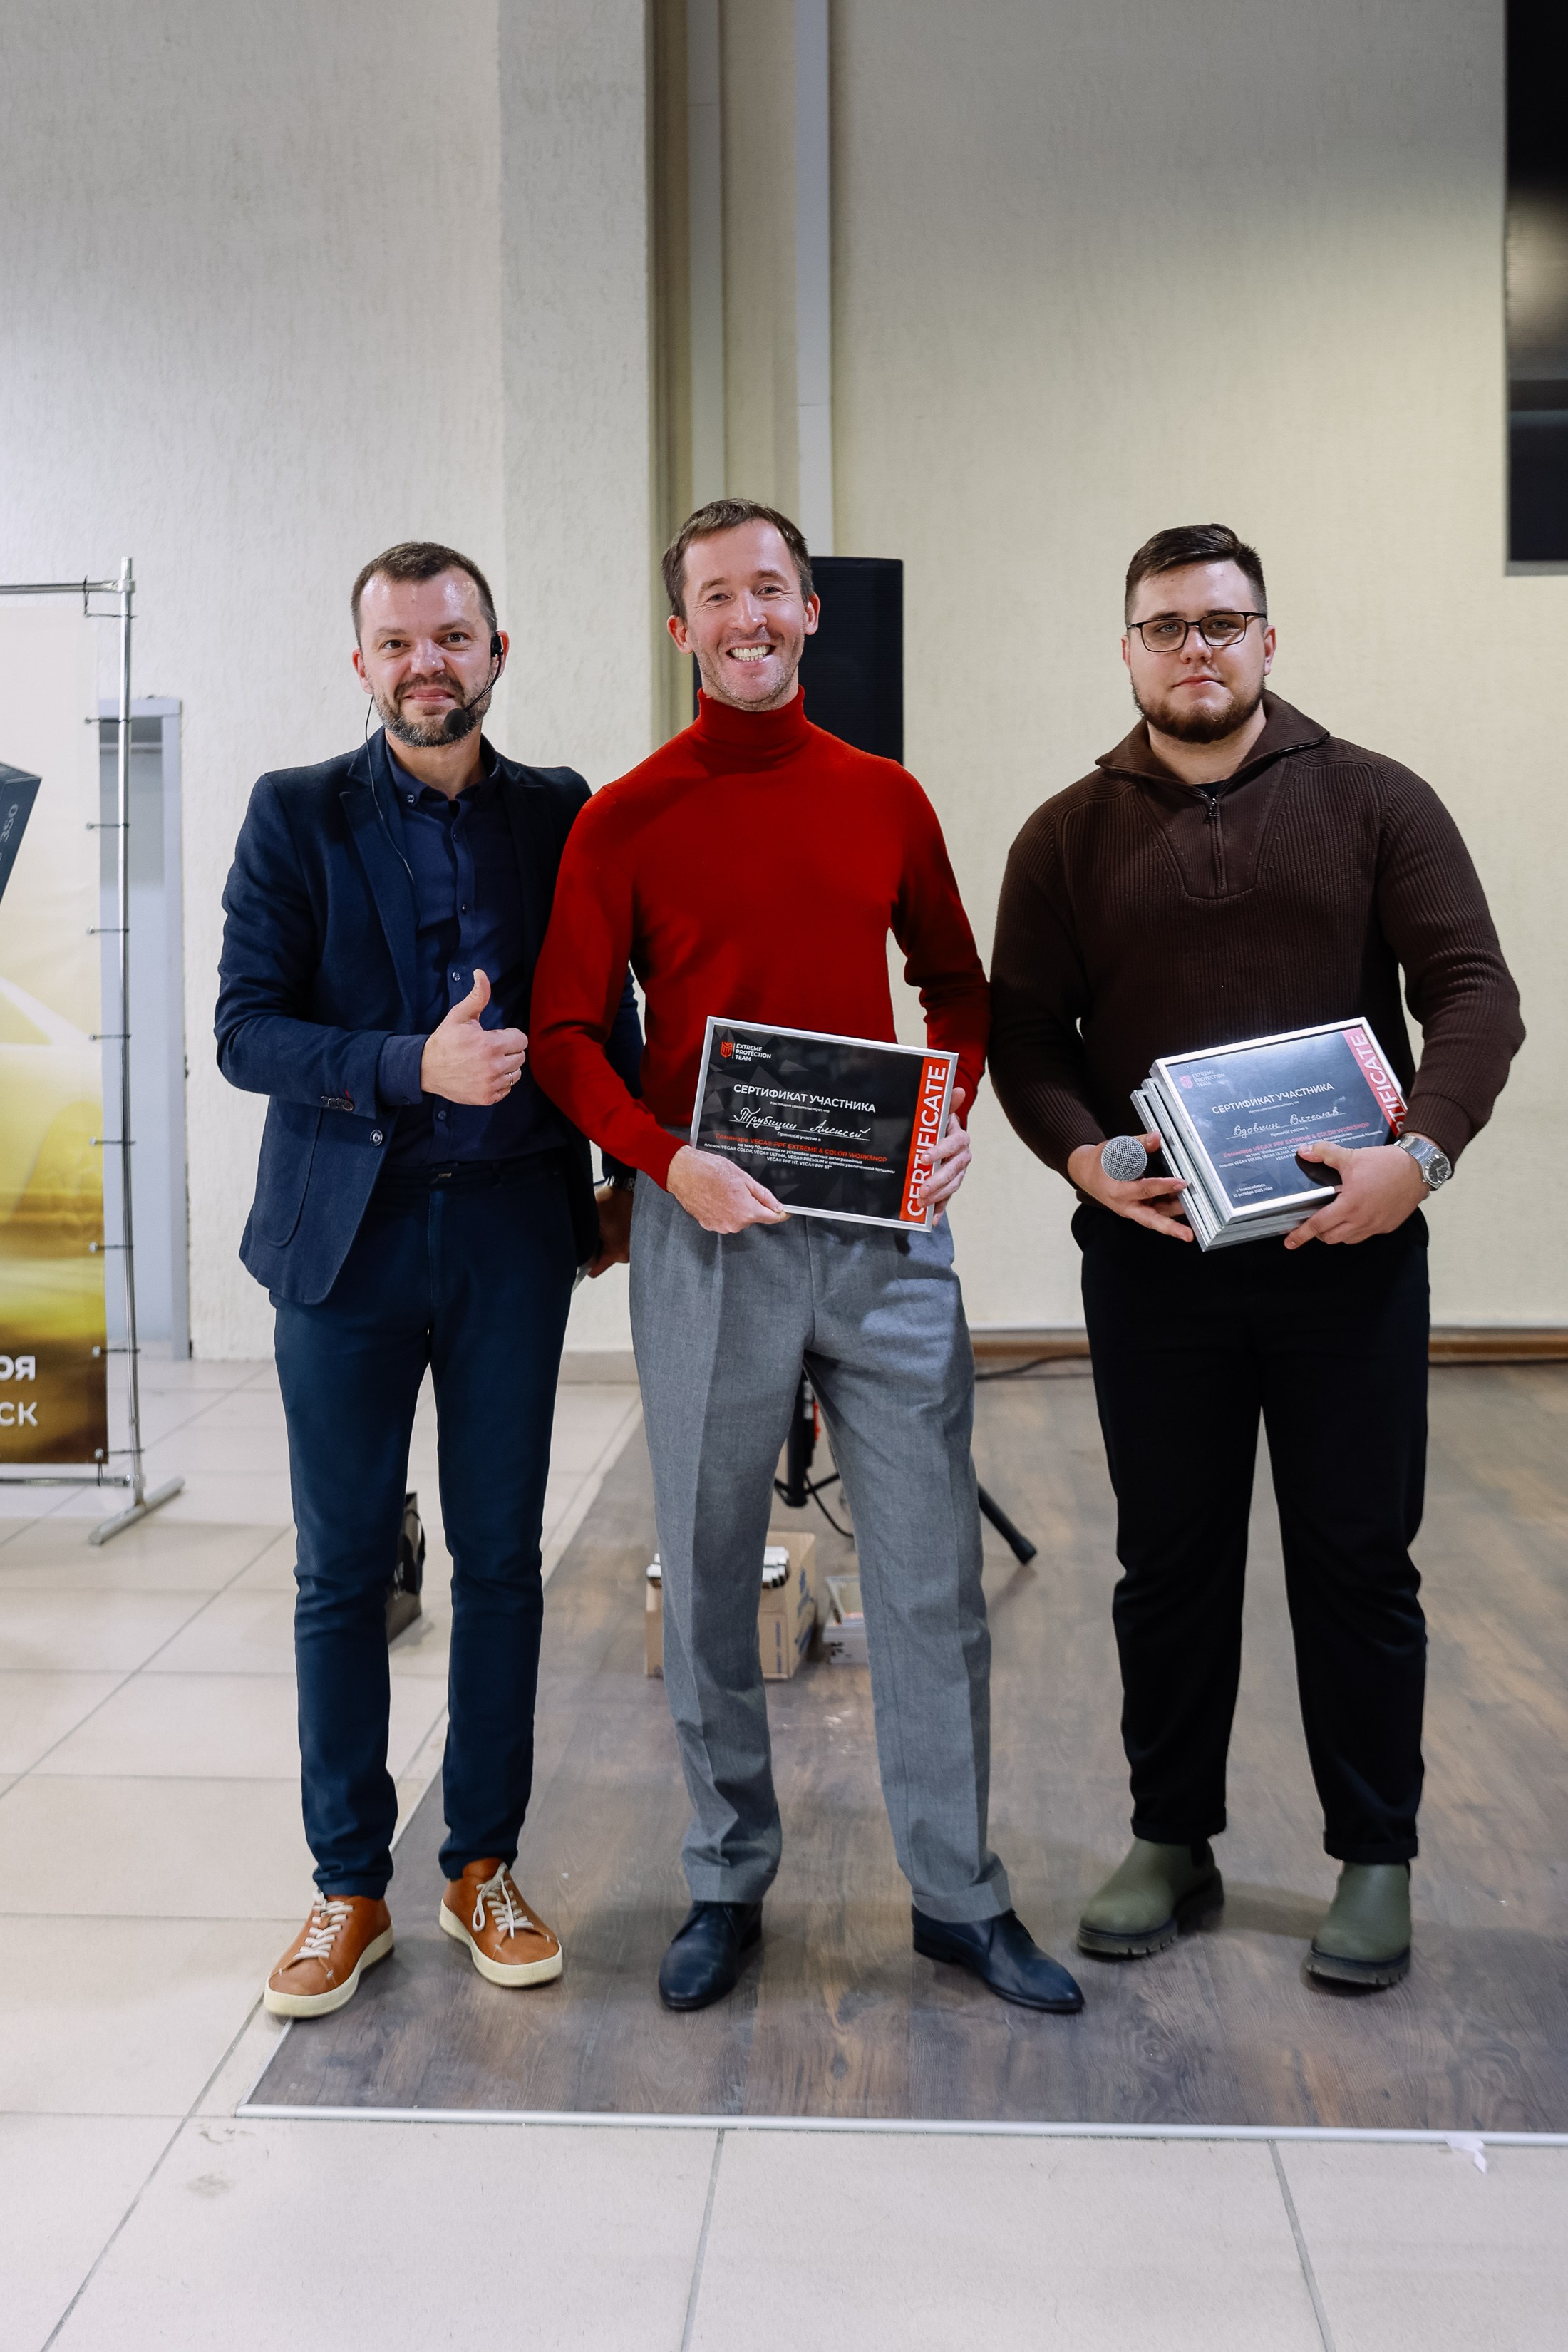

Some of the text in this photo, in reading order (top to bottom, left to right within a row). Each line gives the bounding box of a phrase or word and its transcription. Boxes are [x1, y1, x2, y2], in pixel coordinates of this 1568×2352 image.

[735, 1048, 771, 1059] PROTECTION
[736, 1043, 762, 1051] EXTREME
[1192, 1070, 1214, 1078] EXTREME
[1194, 1073, 1226, 1083] PROTECTION
[1350, 1033, 1405, 1131] TIFICATE
[733, 1083, 877, 1113] СЕРТИФИКАТ УЧАСТНИКА
[1211, 1095, 1276, 1114] СЕРТИФИКАТ
[1275, 1083, 1334, 1101] УЧАСТНИКА
[809, 1119, 870, 1137] Алексей
[788, 1143, 817, 1152] EXTREME
[847, 1152, 887, 1162] WORKSHOP
